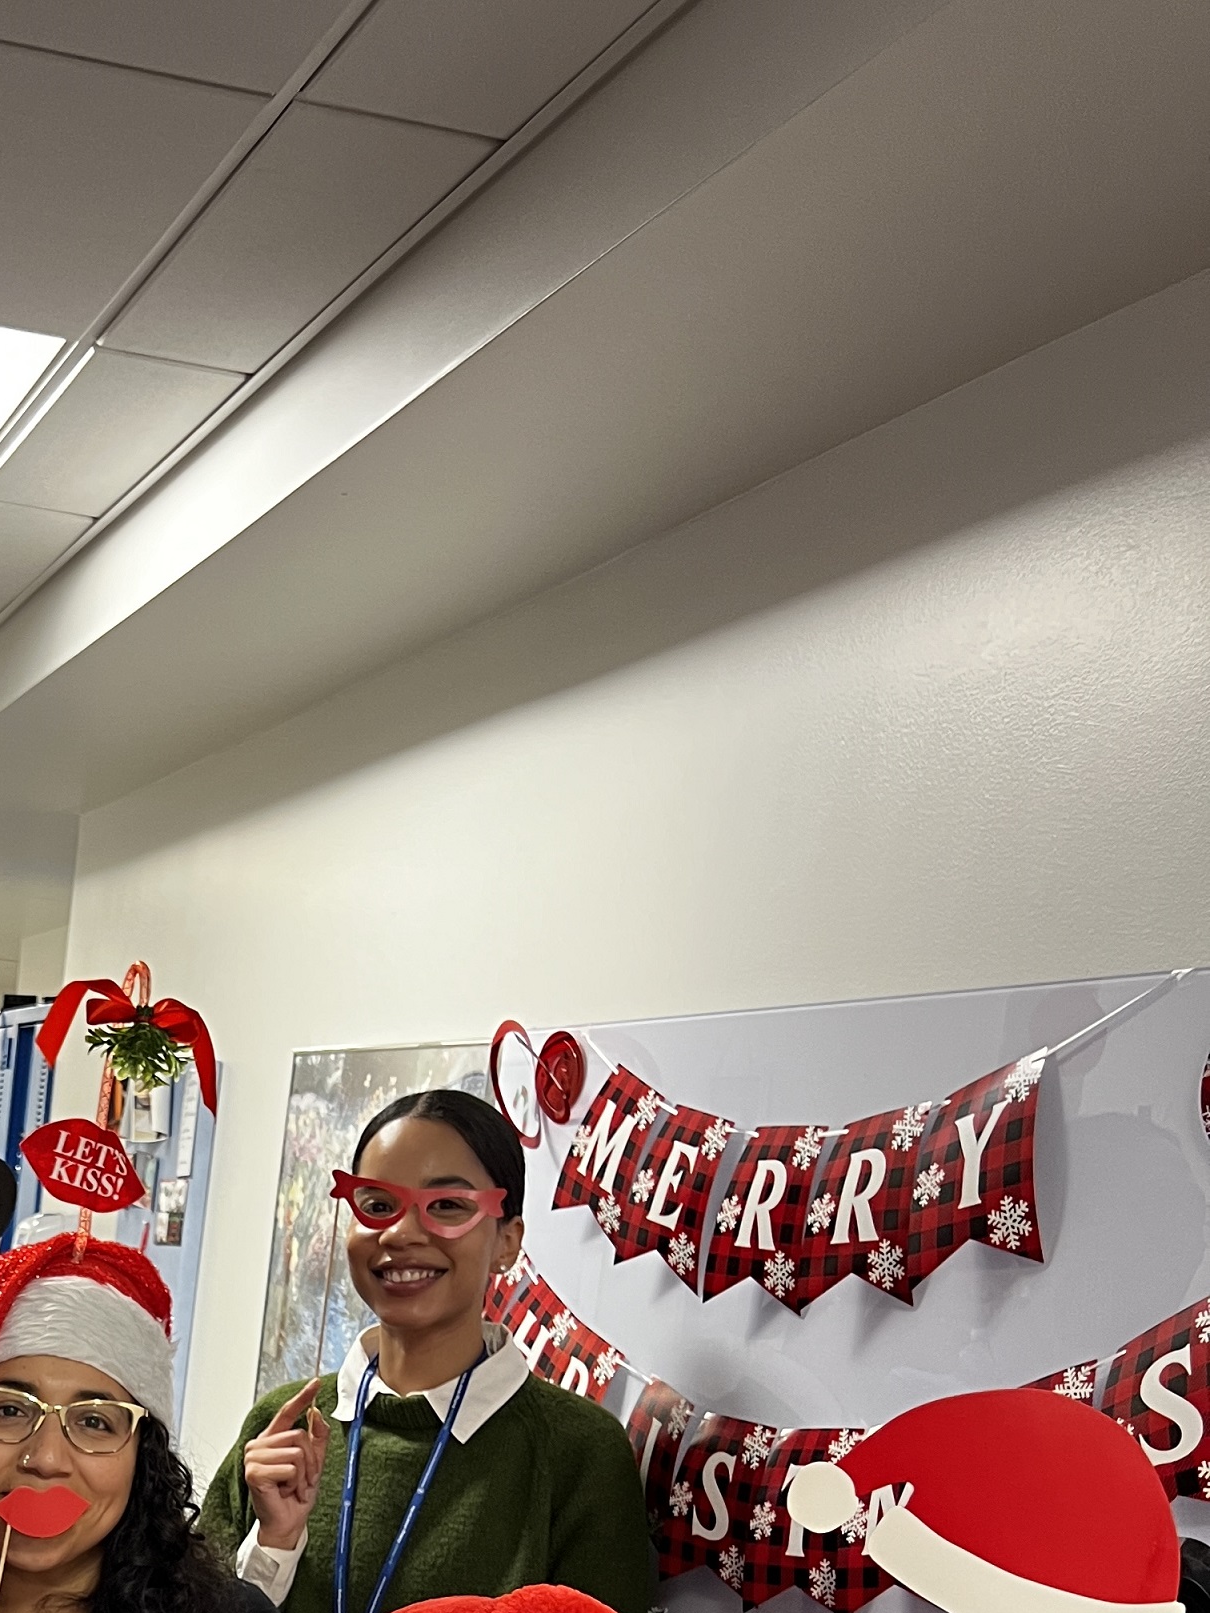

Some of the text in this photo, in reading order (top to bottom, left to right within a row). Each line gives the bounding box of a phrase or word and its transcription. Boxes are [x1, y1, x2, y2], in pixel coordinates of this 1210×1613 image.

[53, 1130, 128, 1176] LET'S
[577, 1098, 1013, 1251] MERRY
[49, 1156, 124, 1200] KISS!
